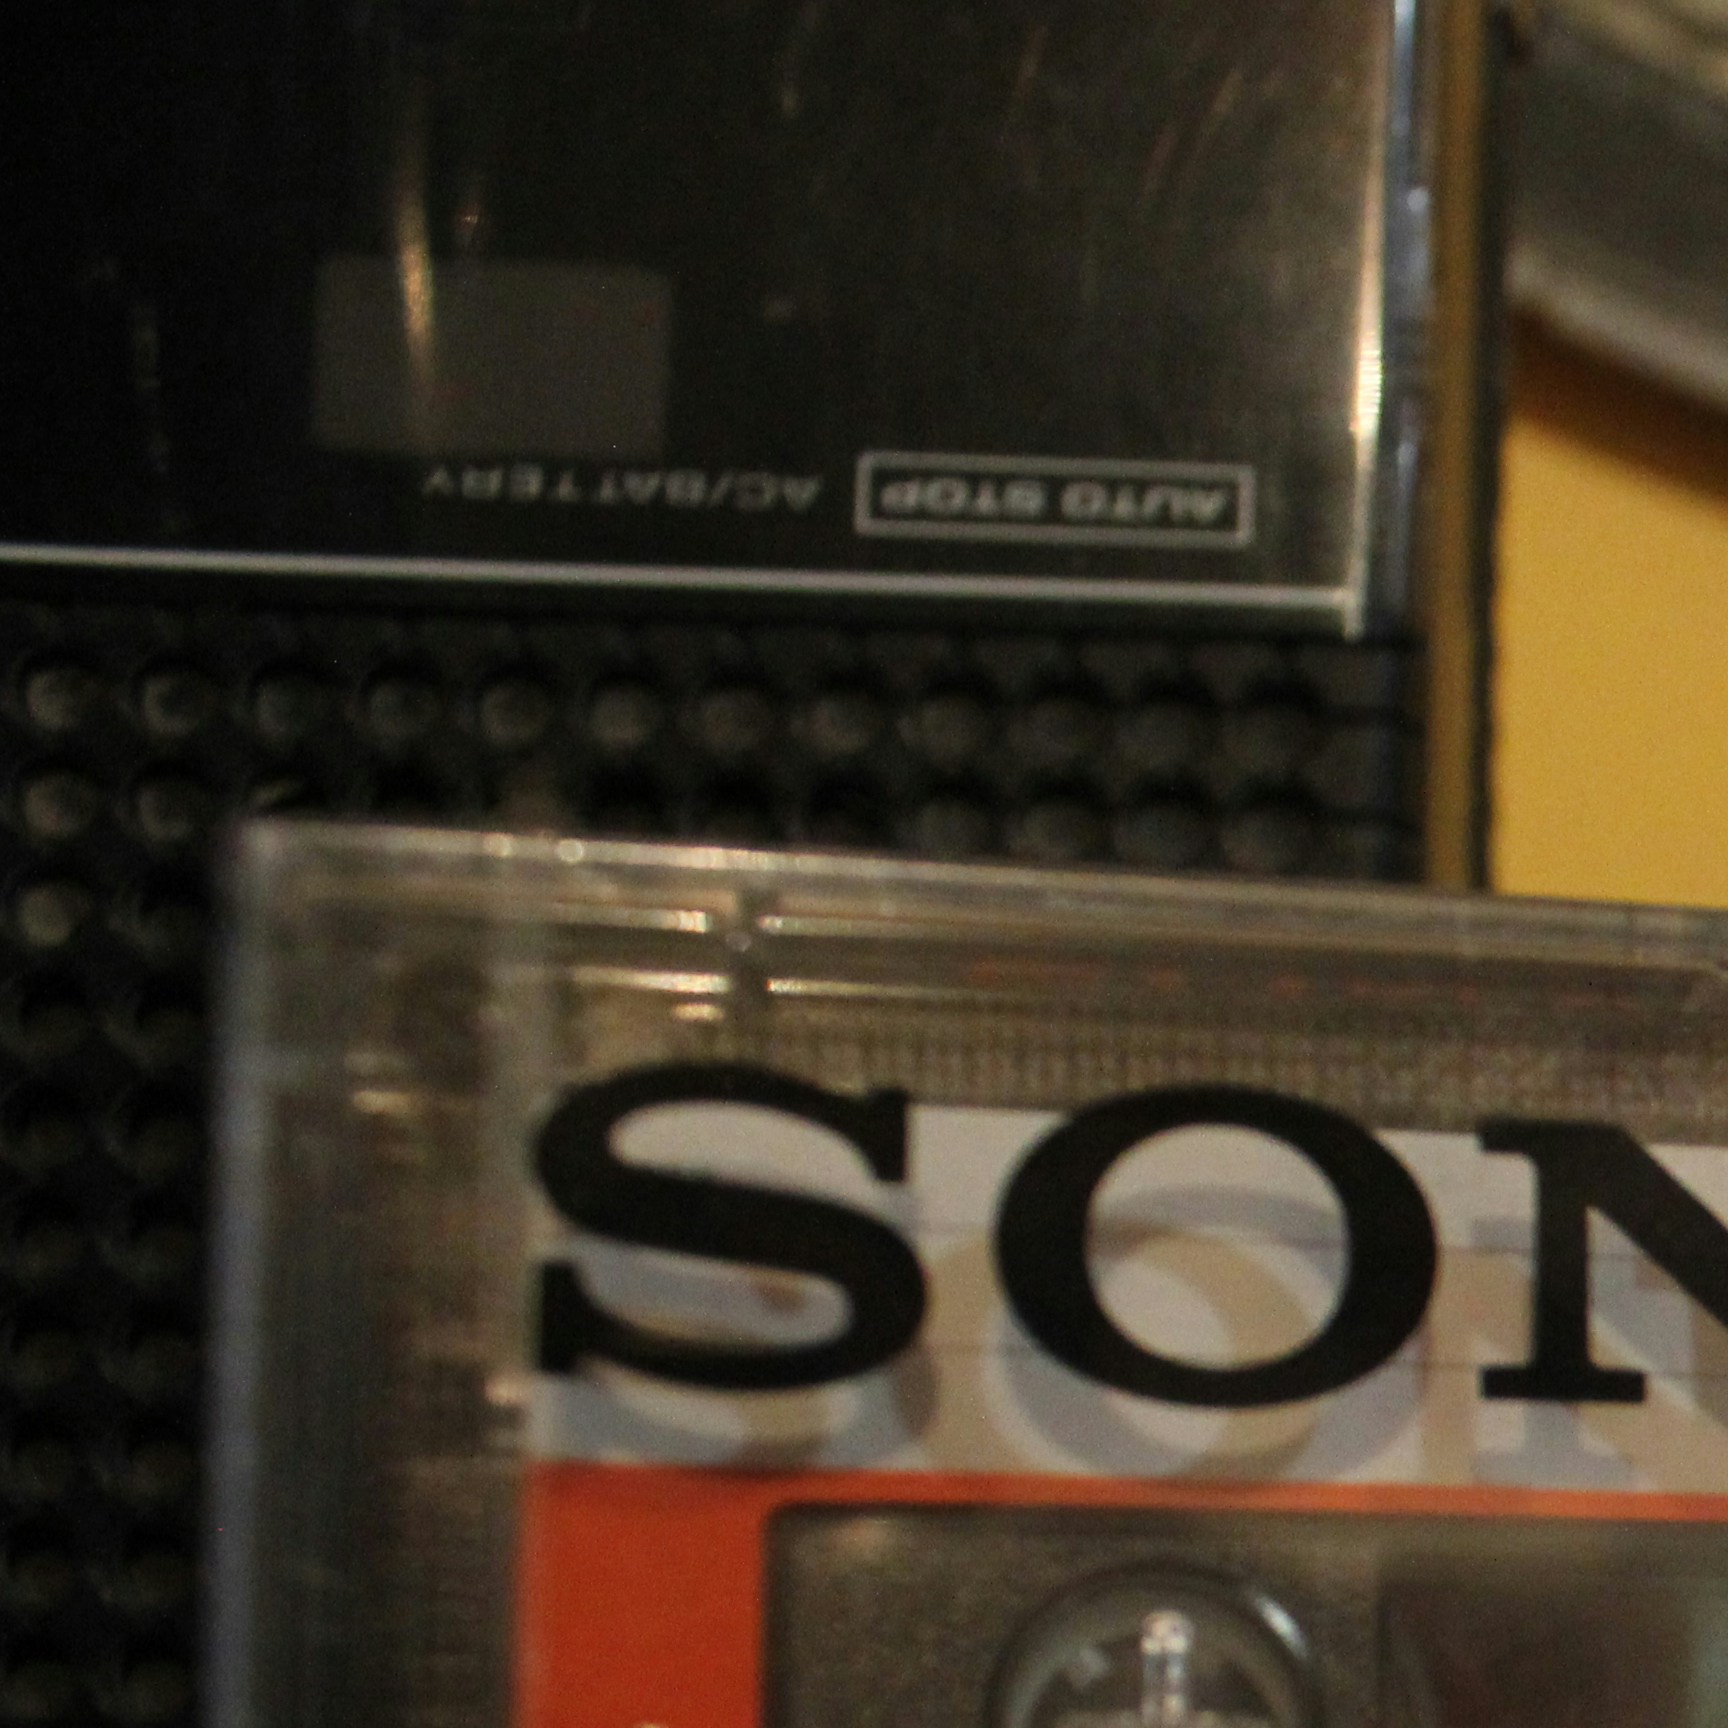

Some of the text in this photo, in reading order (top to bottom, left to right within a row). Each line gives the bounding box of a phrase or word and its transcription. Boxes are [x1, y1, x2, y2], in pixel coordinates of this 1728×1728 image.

[421, 462, 824, 513] AC/BATTERY
[879, 477, 1227, 526] AUTO STOP
